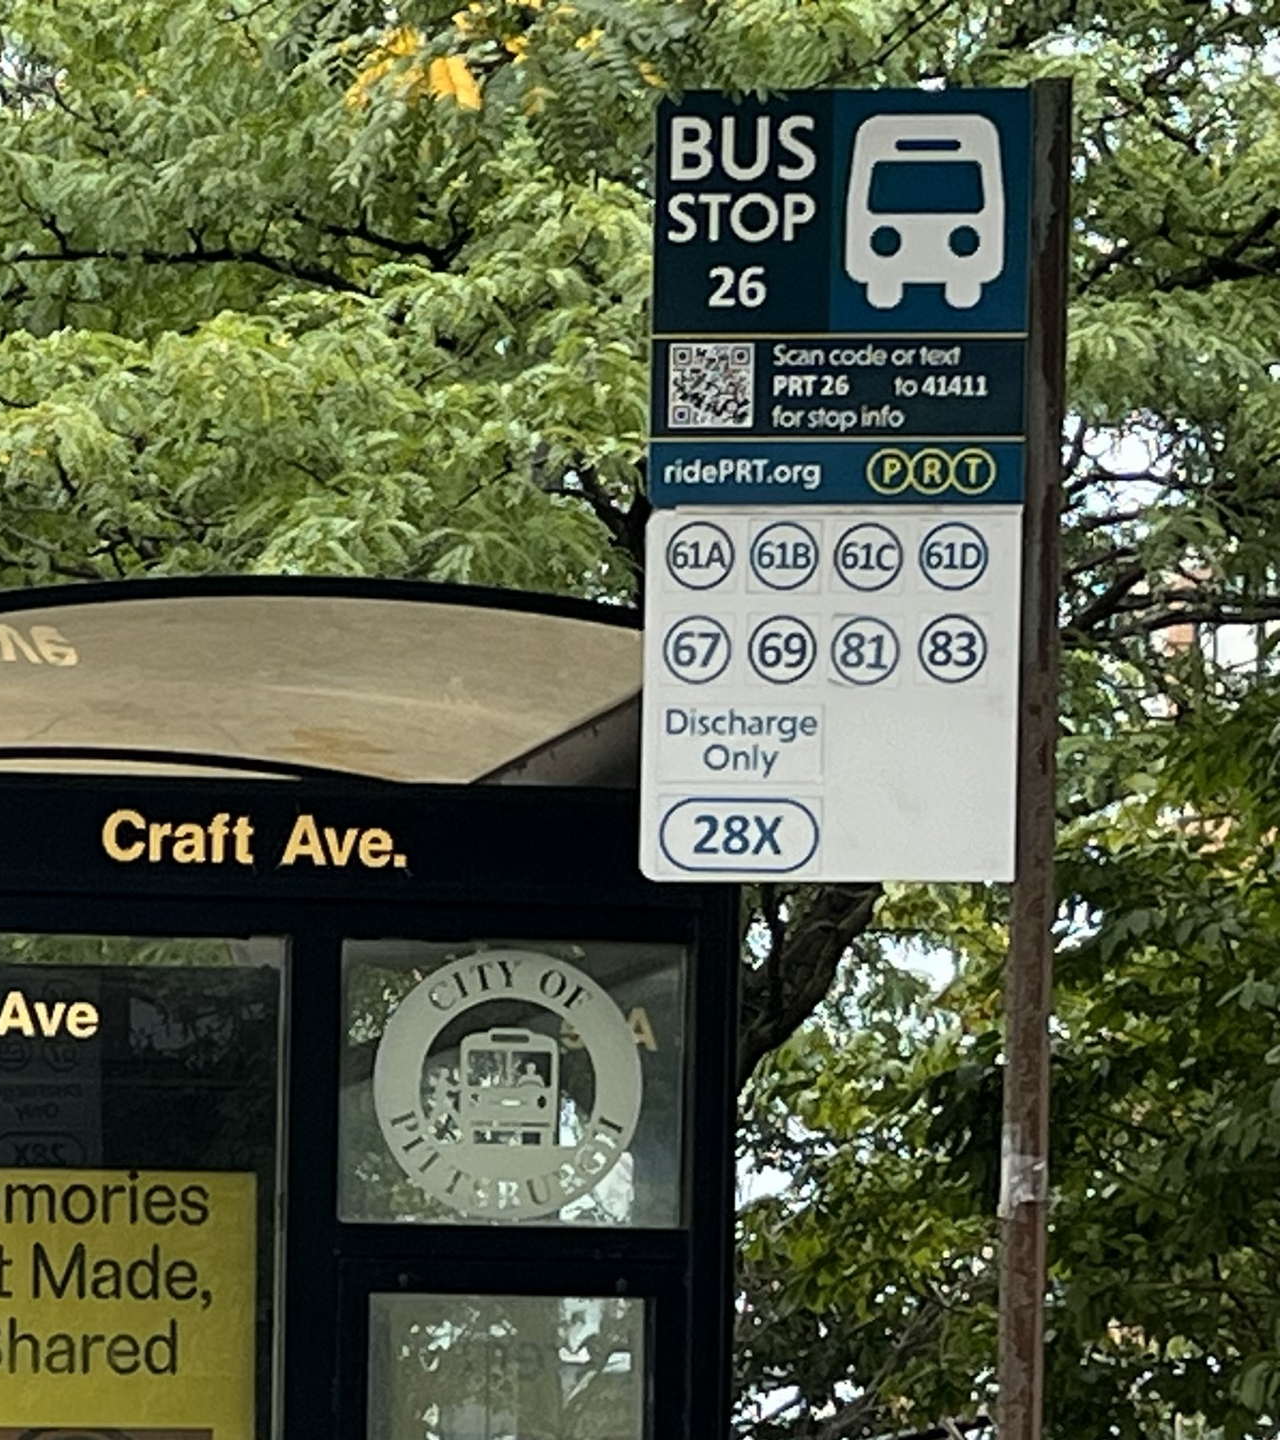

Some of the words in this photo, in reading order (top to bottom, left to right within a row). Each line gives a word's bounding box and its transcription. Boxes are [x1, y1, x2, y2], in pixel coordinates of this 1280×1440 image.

[669, 114, 817, 181] BUS
[666, 192, 817, 244] STOP
[707, 266, 768, 308] 26
[772, 344, 826, 368] Scan
[828, 344, 887, 368] code
[890, 349, 916, 368] or
[919, 345, 961, 367] text
[772, 374, 819, 398] PRT
[820, 373, 850, 398] 26
[893, 375, 919, 398] to
[921, 374, 989, 398] 41411
[771, 406, 806, 429] for
[807, 410, 858, 434] stop
[861, 405, 906, 428] info
[663, 457, 822, 490] ridePRT.org
[671, 543, 727, 570] 61A
[756, 544, 812, 570] 61B
[840, 544, 898, 571] 61C
[925, 544, 984, 570] 61D
[672, 631, 722, 668] 67
[758, 632, 808, 668] 69
[840, 632, 888, 670] 81
[927, 631, 977, 668] 83
[665, 709, 818, 743] Discharge
[703, 743, 780, 777] Only
[102, 808, 254, 865] Craft
[281, 814, 408, 869] Ave.
[693, 814, 783, 856] 28X
[427, 960, 520, 1011] CITY
[539, 968, 595, 1010] OF
[31, 1242, 214, 1308] Made,
